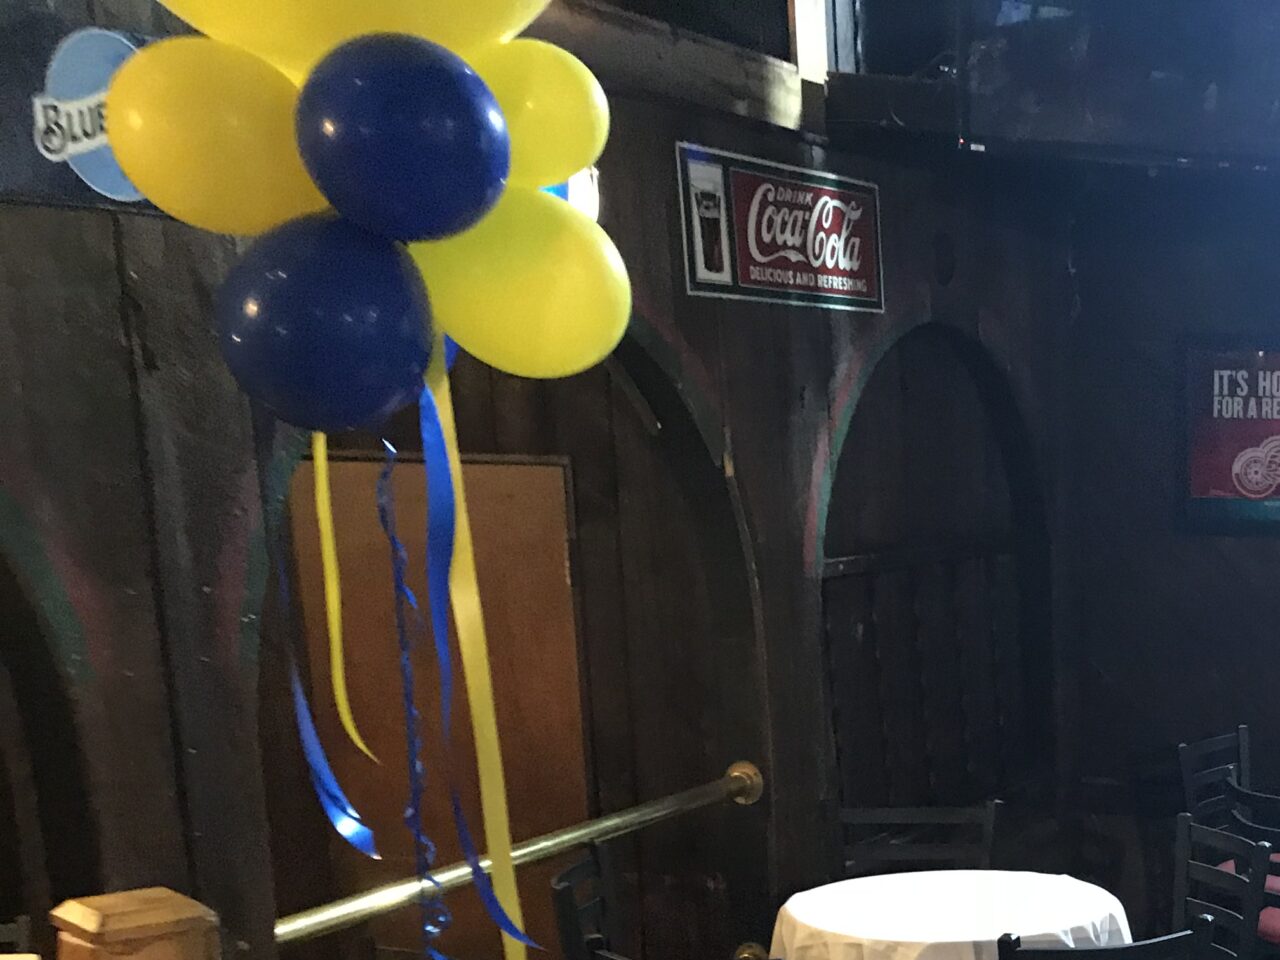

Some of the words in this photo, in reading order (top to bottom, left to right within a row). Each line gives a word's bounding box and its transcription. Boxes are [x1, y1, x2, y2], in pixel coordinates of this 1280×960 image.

[776, 187, 814, 206] DRINK
[747, 183, 863, 272] Coca-Cola
[749, 265, 794, 285] DELICIOUS
[795, 270, 815, 288] AND
[816, 274, 868, 292] REFRESHING
[1213, 369, 1249, 397] IT'S
[1212, 396, 1244, 419] FOR
[1246, 397, 1258, 419] A
